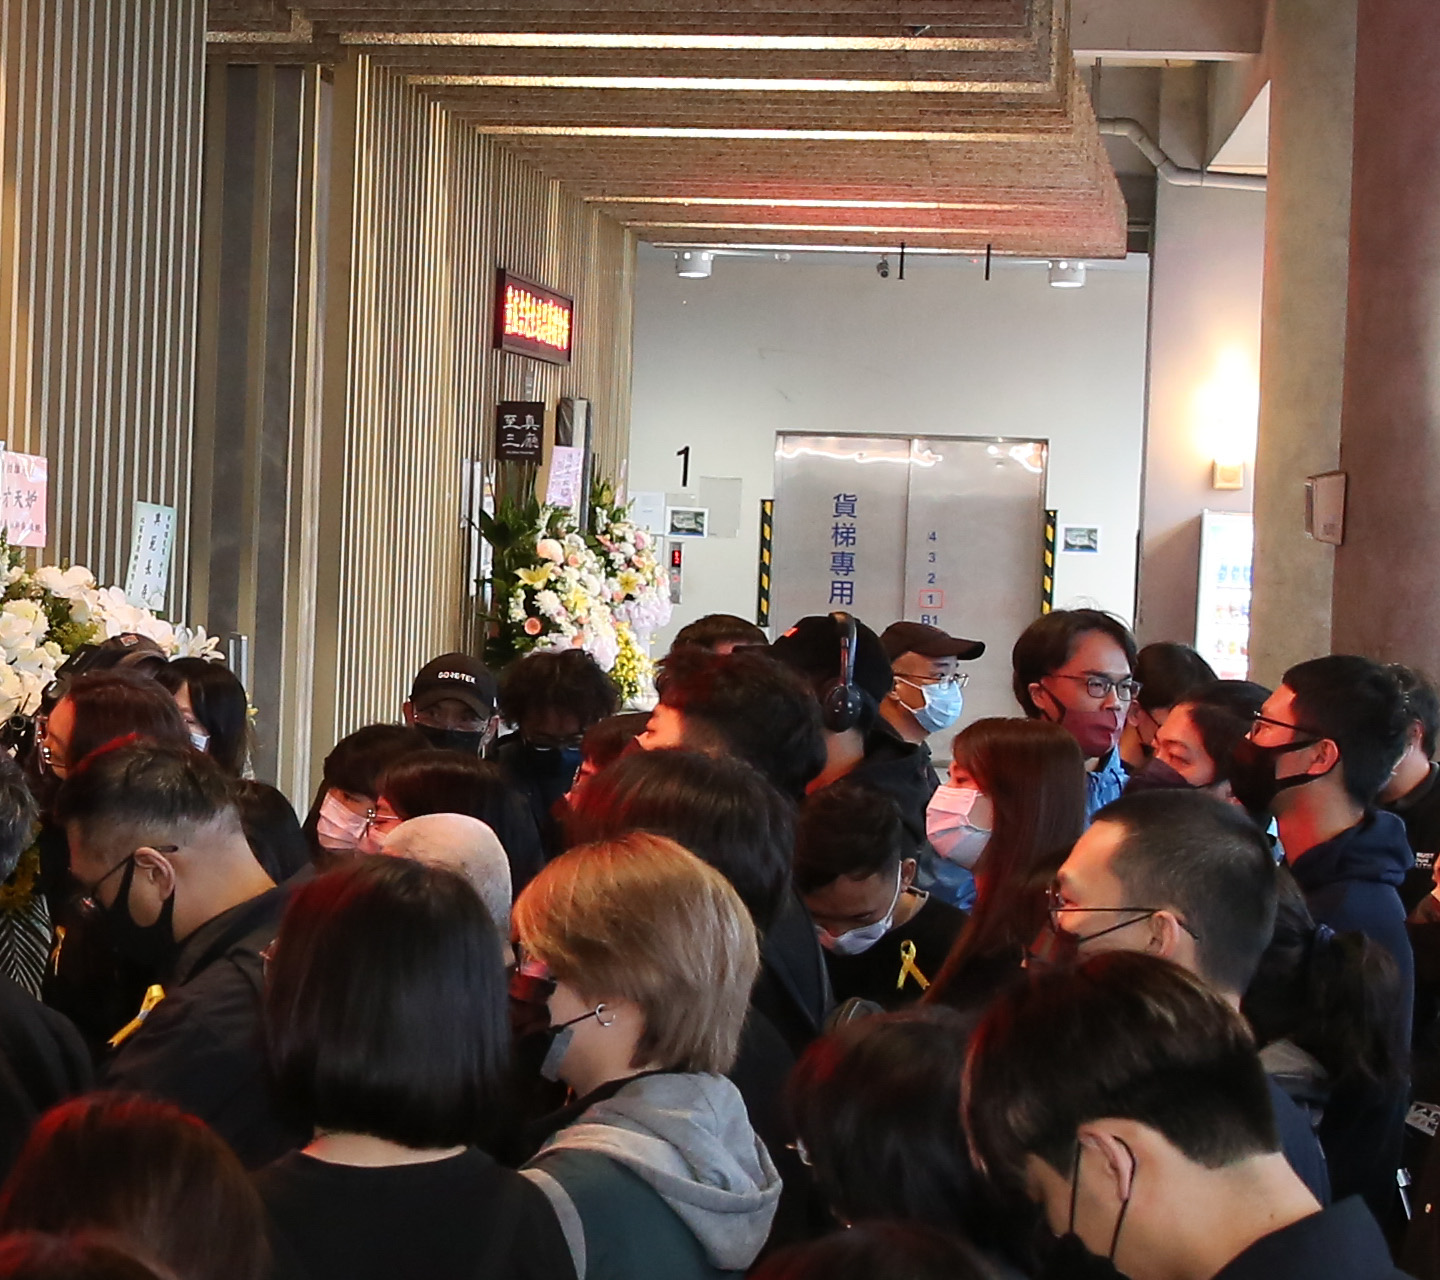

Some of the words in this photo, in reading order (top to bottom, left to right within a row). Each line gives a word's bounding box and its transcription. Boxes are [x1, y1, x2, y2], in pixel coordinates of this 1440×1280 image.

[676, 445, 690, 488] 1
[929, 531, 937, 542] 4
[829, 493, 858, 605] 貨梯專用
[928, 552, 936, 563] 3
[927, 573, 935, 584] 2
[928, 594, 934, 604] 1
[921, 614, 938, 625] B1
